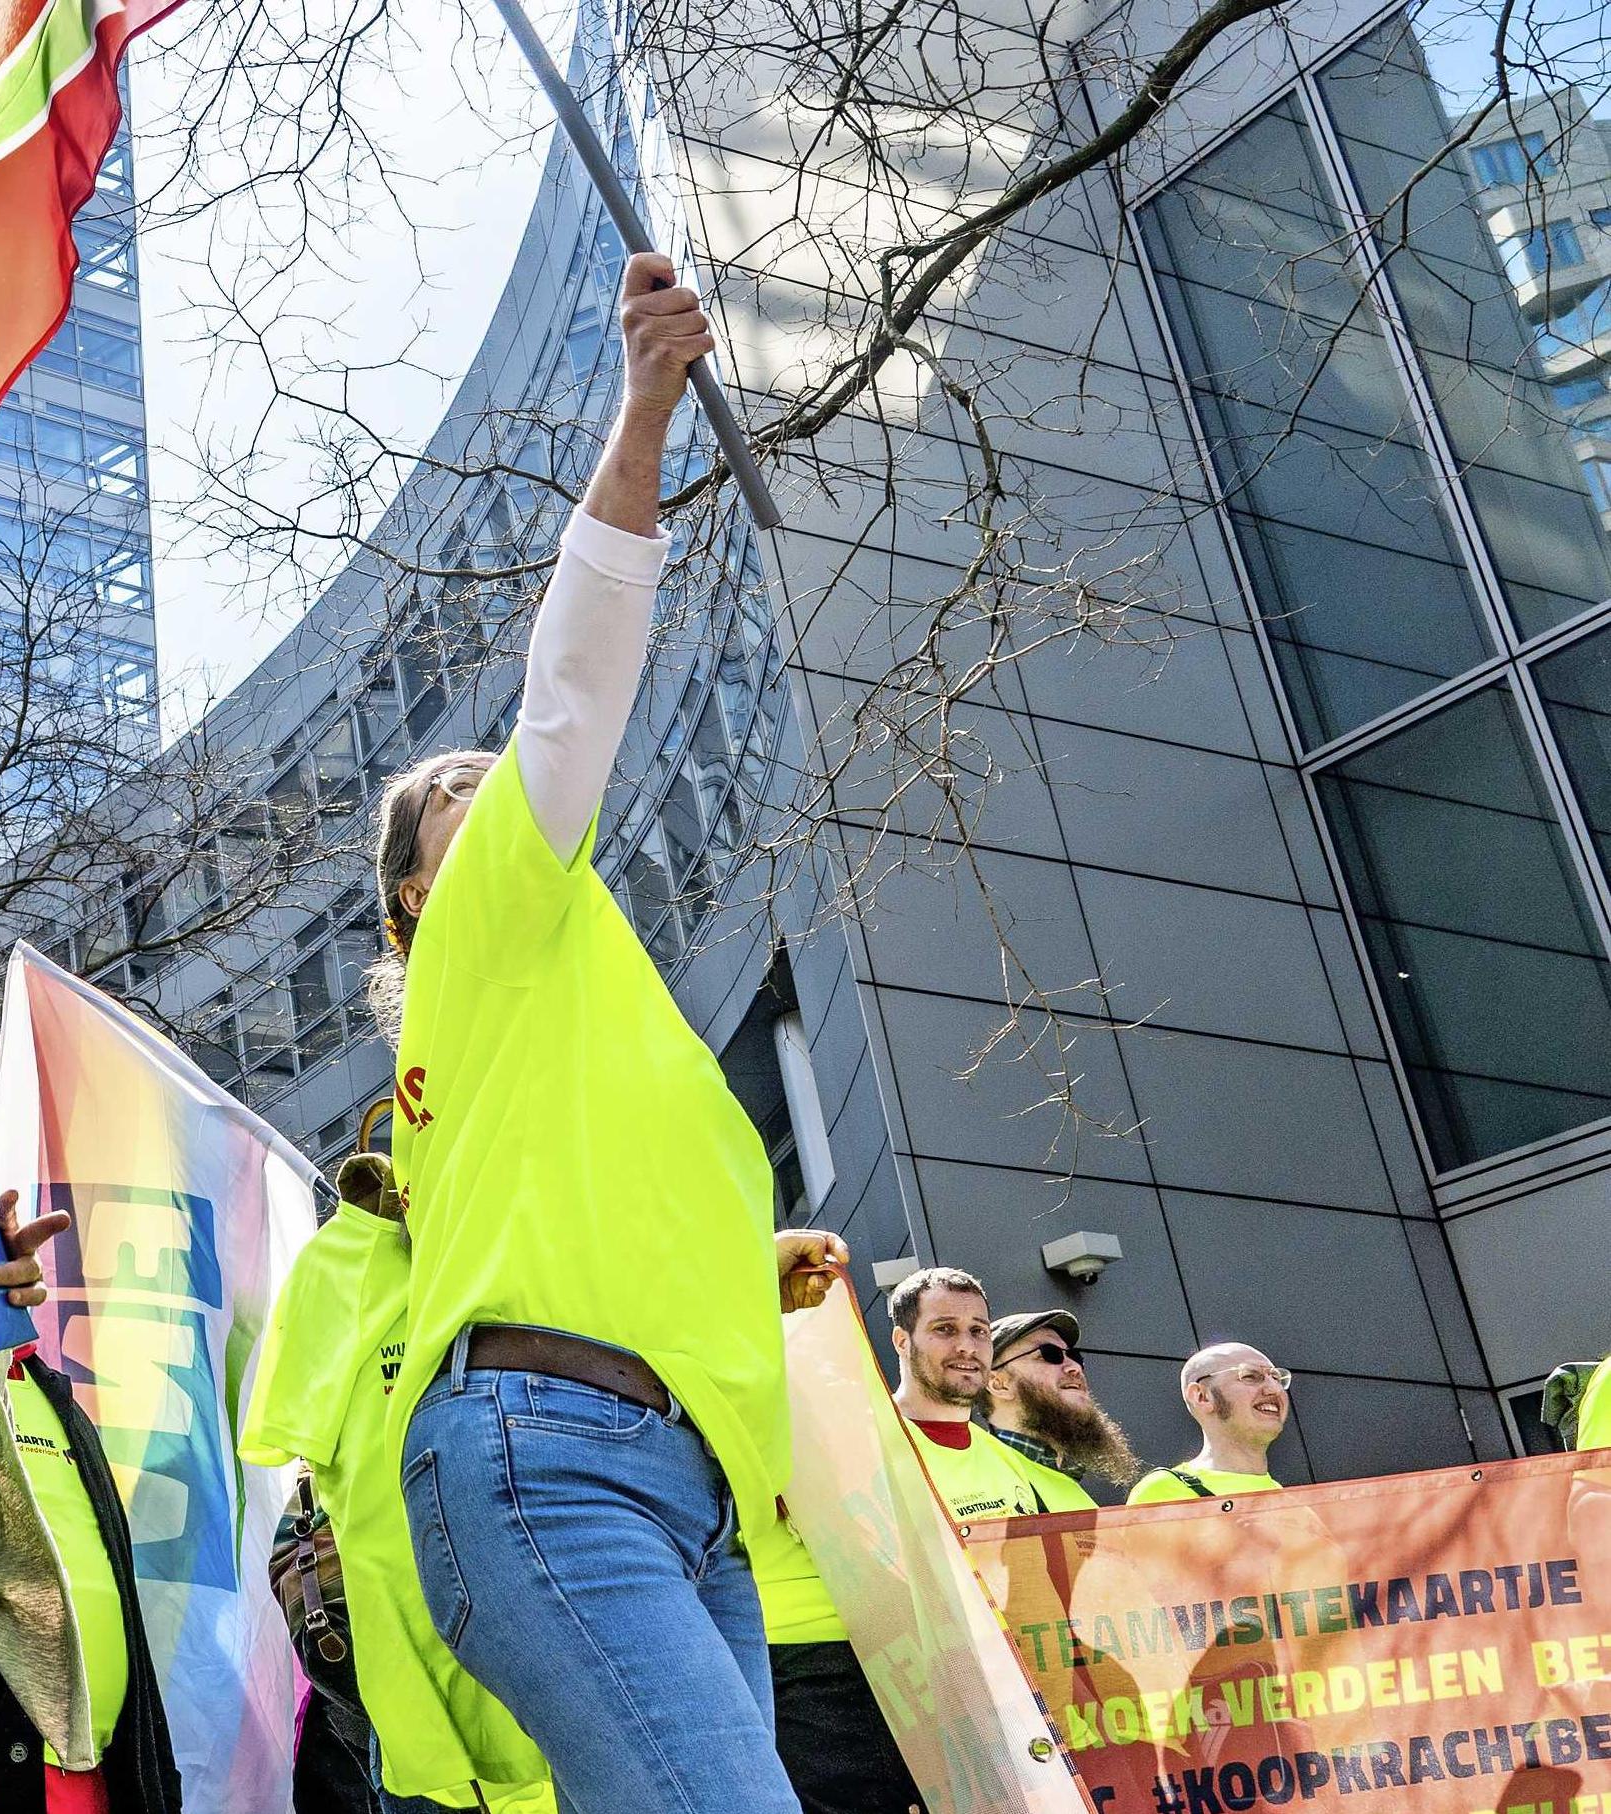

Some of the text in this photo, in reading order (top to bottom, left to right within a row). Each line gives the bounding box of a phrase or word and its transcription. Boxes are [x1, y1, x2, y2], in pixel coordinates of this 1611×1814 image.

[1016, 1558, 1583, 1673] TEAMVISITEKAARTJE
[1065, 1685, 1212, 1752] KOEK
[1220, 1646, 1504, 1728] VERDELEN
[1152, 1713, 1611, 1814] #KOOPKRACHTBE
